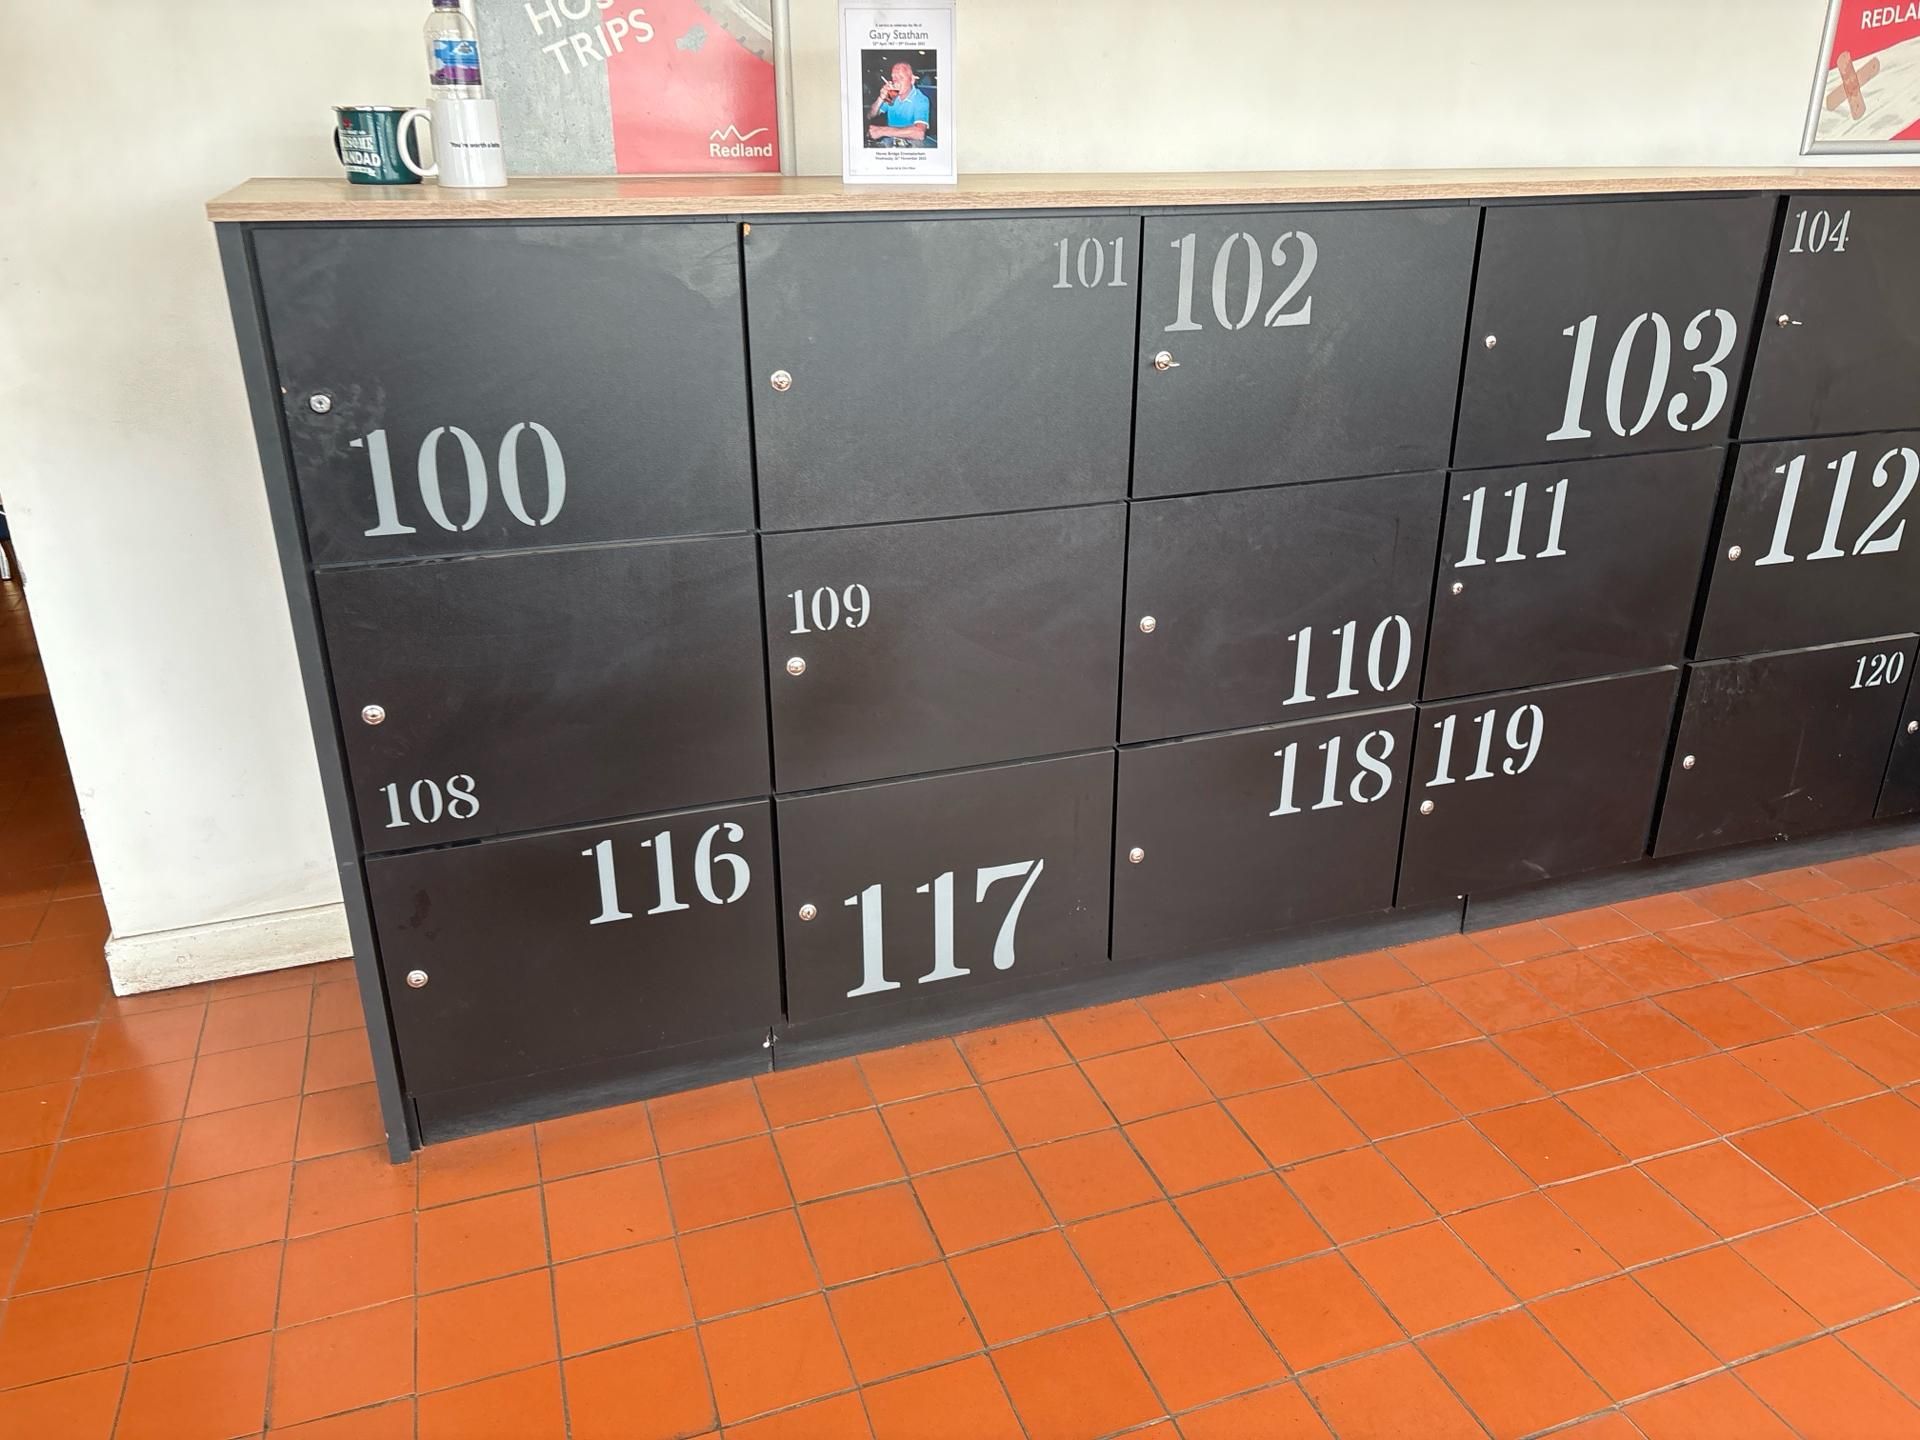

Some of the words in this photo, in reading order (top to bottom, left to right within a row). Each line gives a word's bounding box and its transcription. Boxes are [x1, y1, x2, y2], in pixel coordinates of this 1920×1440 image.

[524, 0, 616, 36] HO
[542, 8, 656, 75] TRIPS
[869, 29, 891, 42] Gary
[893, 29, 929, 40] Statham
[1861, 2, 1920, 30] REDLA
[709, 143, 773, 157] Redland
[1052, 236, 1128, 288] 101
[1789, 210, 1850, 253] 104
[1165, 230, 1318, 332] 102
[1546, 308, 1737, 441] 103
[349, 421, 567, 537] 100
[1755, 447, 1919, 566] 112
[1455, 478, 1569, 568] 111
[788, 583, 871, 634] 109
[1283, 614, 1415, 713] 110
[1850, 651, 1905, 689] 120
[1269, 729, 1395, 817] 118
[1426, 704, 1544, 787] 119
[380, 774, 480, 828] 108
[582, 813, 751, 925] 116
[844, 858, 1044, 998] 117
